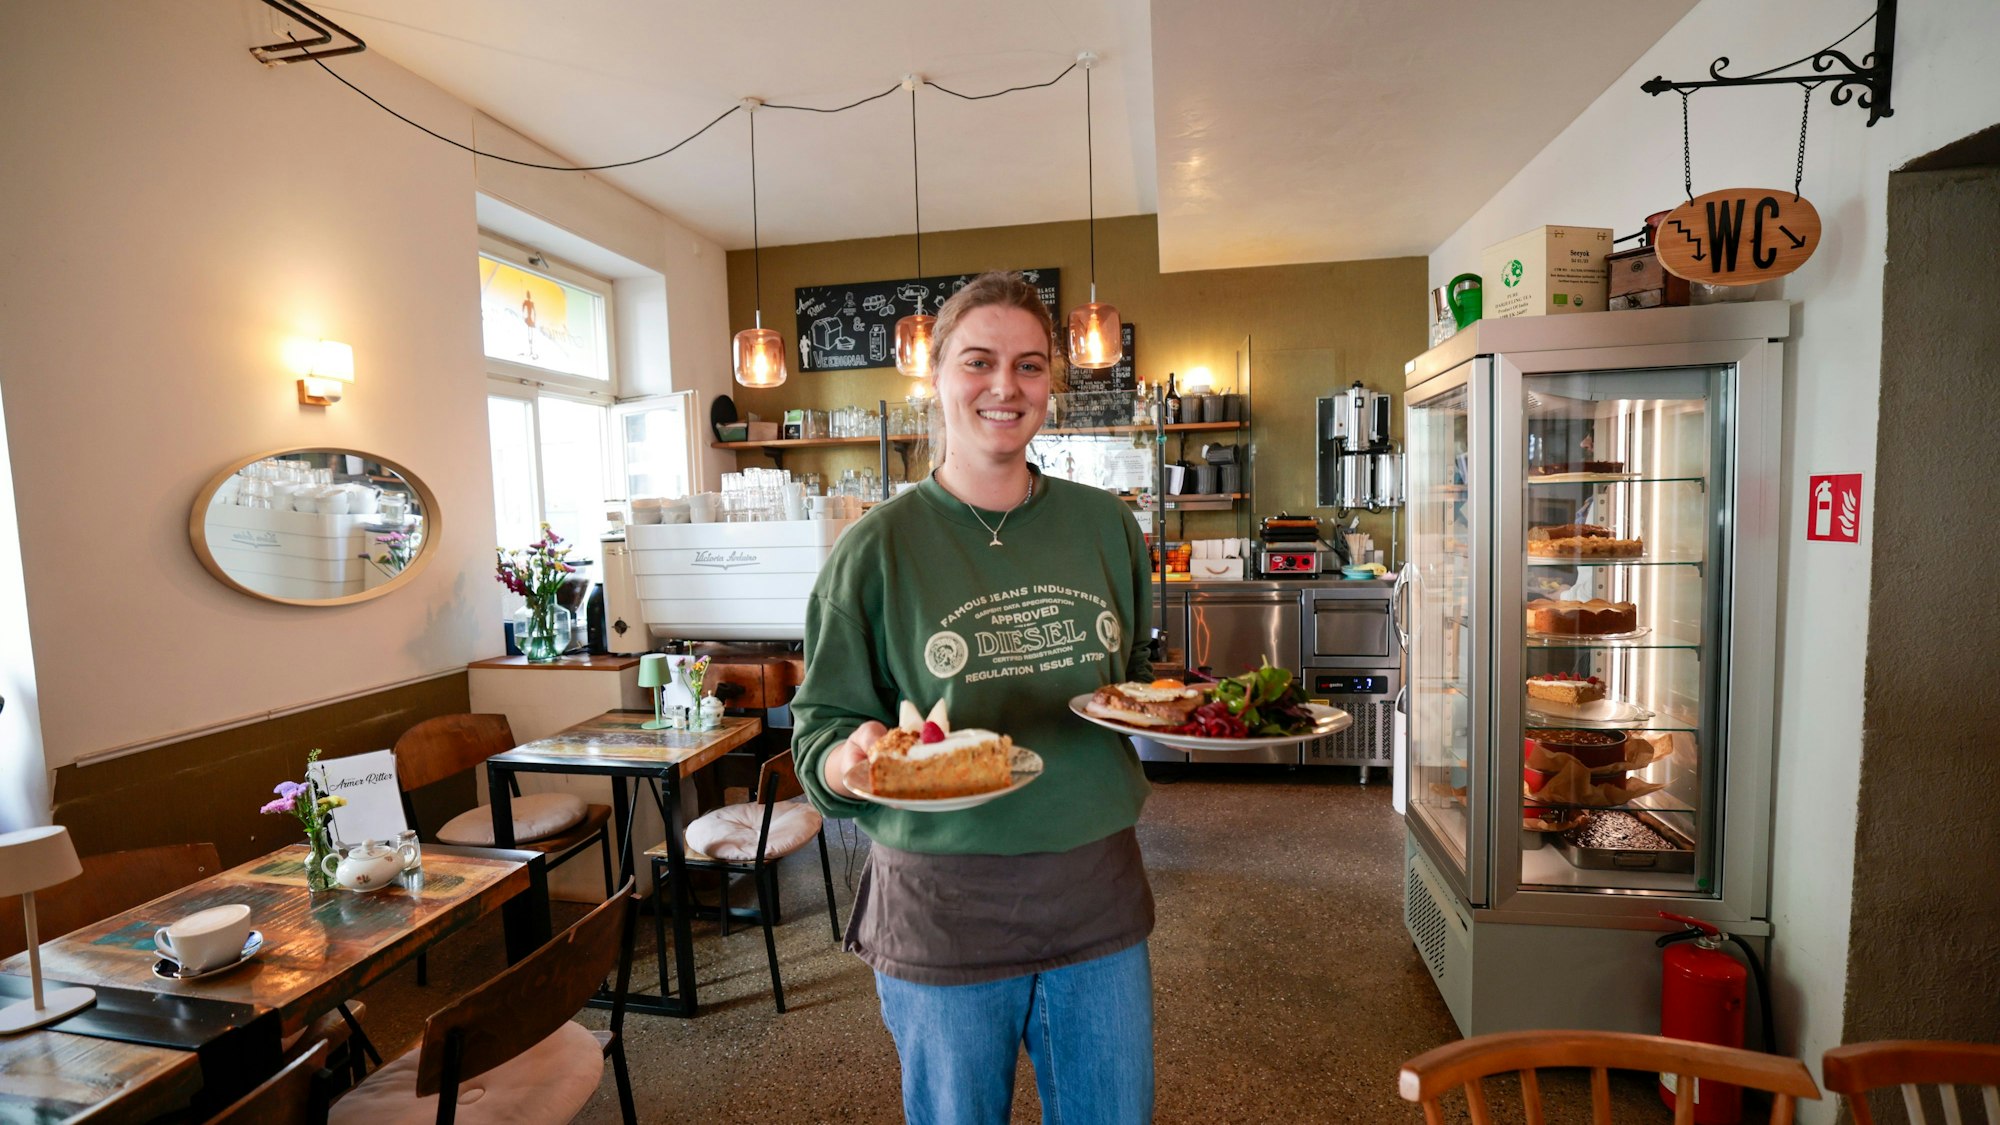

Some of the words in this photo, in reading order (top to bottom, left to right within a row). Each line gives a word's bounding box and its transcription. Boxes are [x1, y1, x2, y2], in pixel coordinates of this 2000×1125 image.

[1706, 196, 1780, 274] WC
[1570, 249, 1590, 258] Seeyok
[1037, 286, 1056, 294] BLACK
[695, 550, 724, 562] Victoria
[726, 550, 758, 562] Arduino
[940, 596, 988, 628] FAMOUS
[989, 586, 1029, 603] JEANS
[1033, 584, 1107, 608] INDUSTRIES
[1003, 603, 1021, 611] DATA
[1021, 597, 1075, 607] SPECIFICATION
[991, 605, 1060, 625] APPROVED
[974, 619, 1087, 657] DIESEL
[992, 655, 1023, 664] CERTIFIED
[1023, 645, 1074, 660] REGISTRATION
[965, 665, 1034, 684] REGULATION
[1039, 657, 1074, 672] ISSUE
[329, 778, 364, 791] Armer
[365, 772, 393, 784] Ritter
